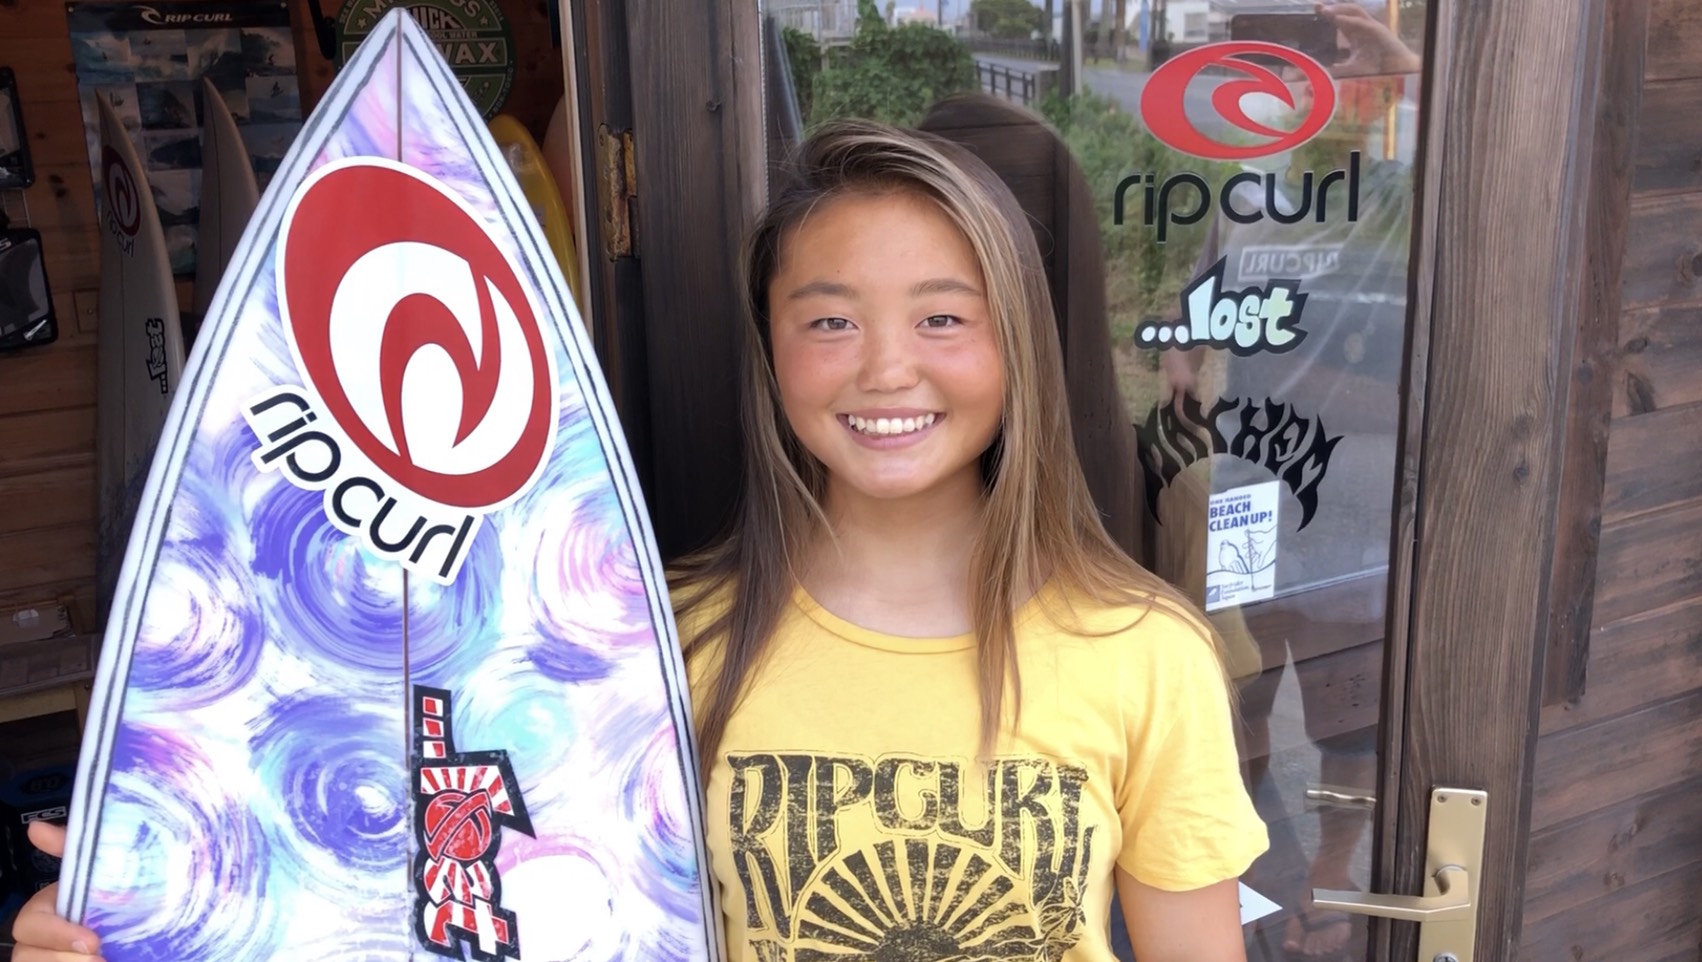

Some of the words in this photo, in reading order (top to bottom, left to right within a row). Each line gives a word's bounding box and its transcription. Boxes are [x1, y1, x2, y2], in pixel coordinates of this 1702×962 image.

[164, 14, 191, 23] RIP
[193, 13, 232, 23] CURL
[249, 392, 342, 483] rip
[331, 476, 475, 578] curl
[1209, 500, 1251, 519] BEACH
